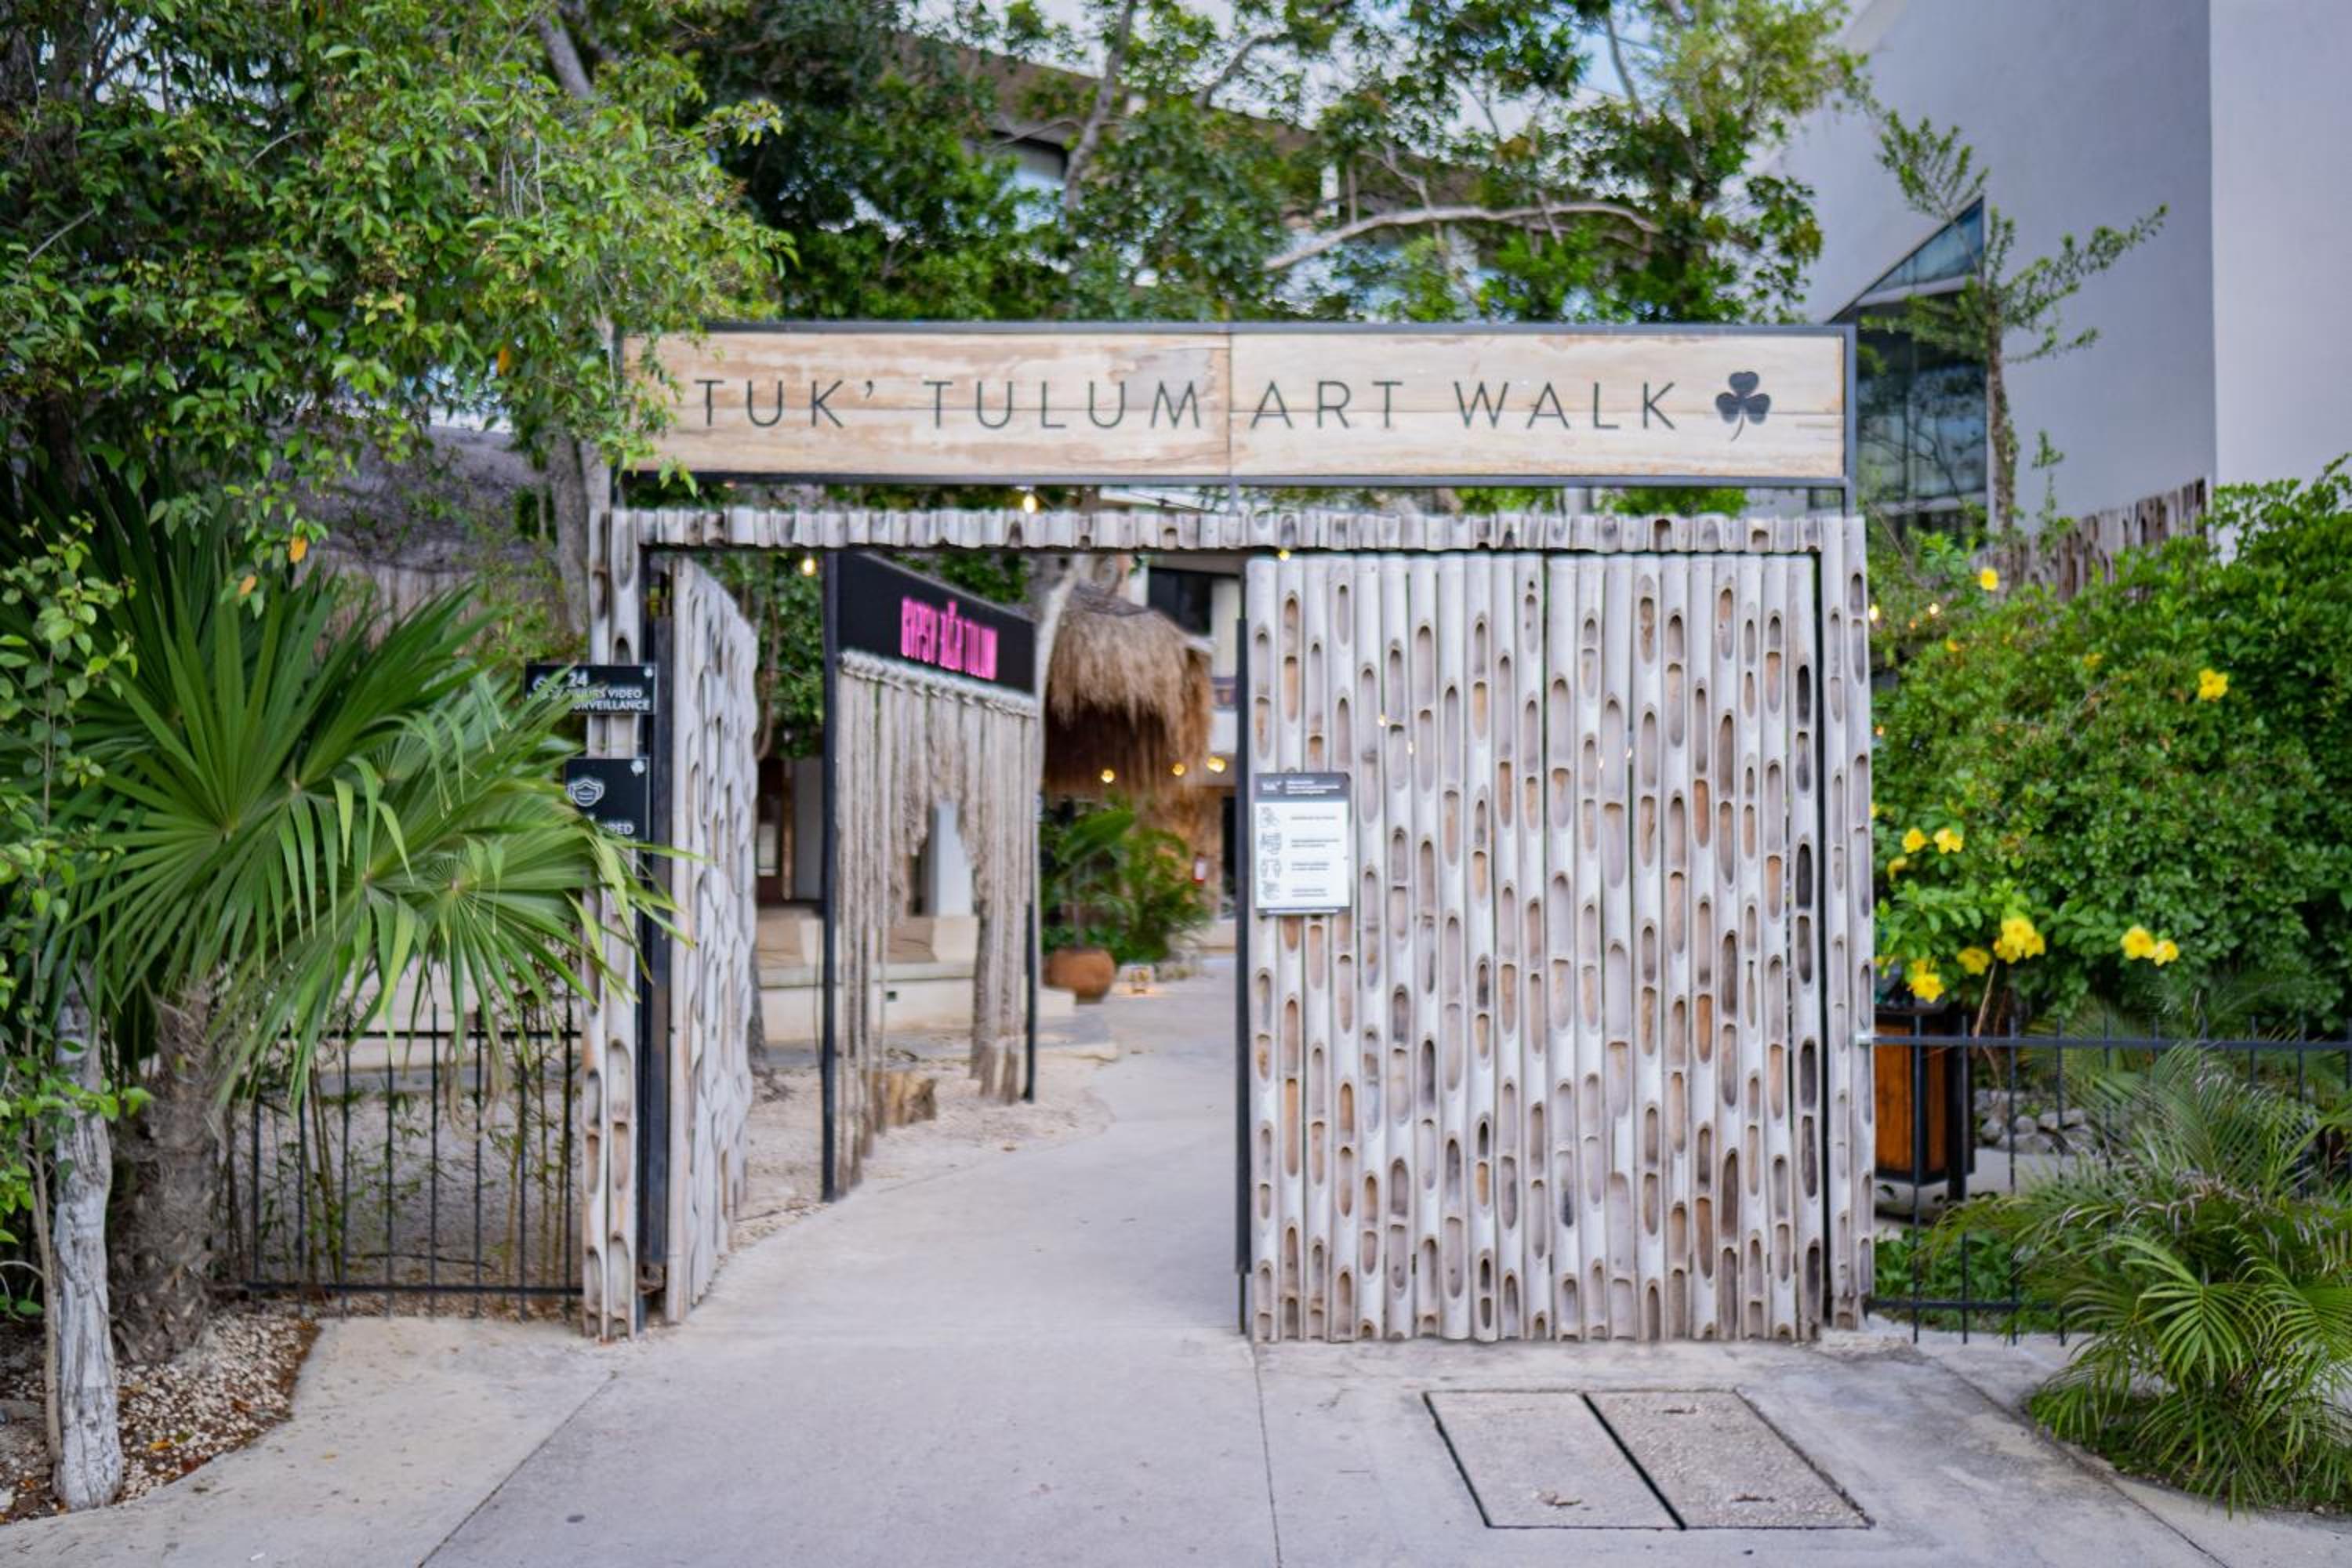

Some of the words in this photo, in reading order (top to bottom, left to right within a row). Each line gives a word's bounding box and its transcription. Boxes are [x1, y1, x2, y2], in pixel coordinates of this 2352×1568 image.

[694, 379, 874, 429] TUK'
[923, 379, 1200, 429] TULUM
[1250, 380, 1403, 429] ART
[1454, 380, 1676, 429] WALK
[568, 670, 589, 687] 24
[608, 688, 643, 699] VIDEO
[572, 699, 651, 711] URVEILLANCE
